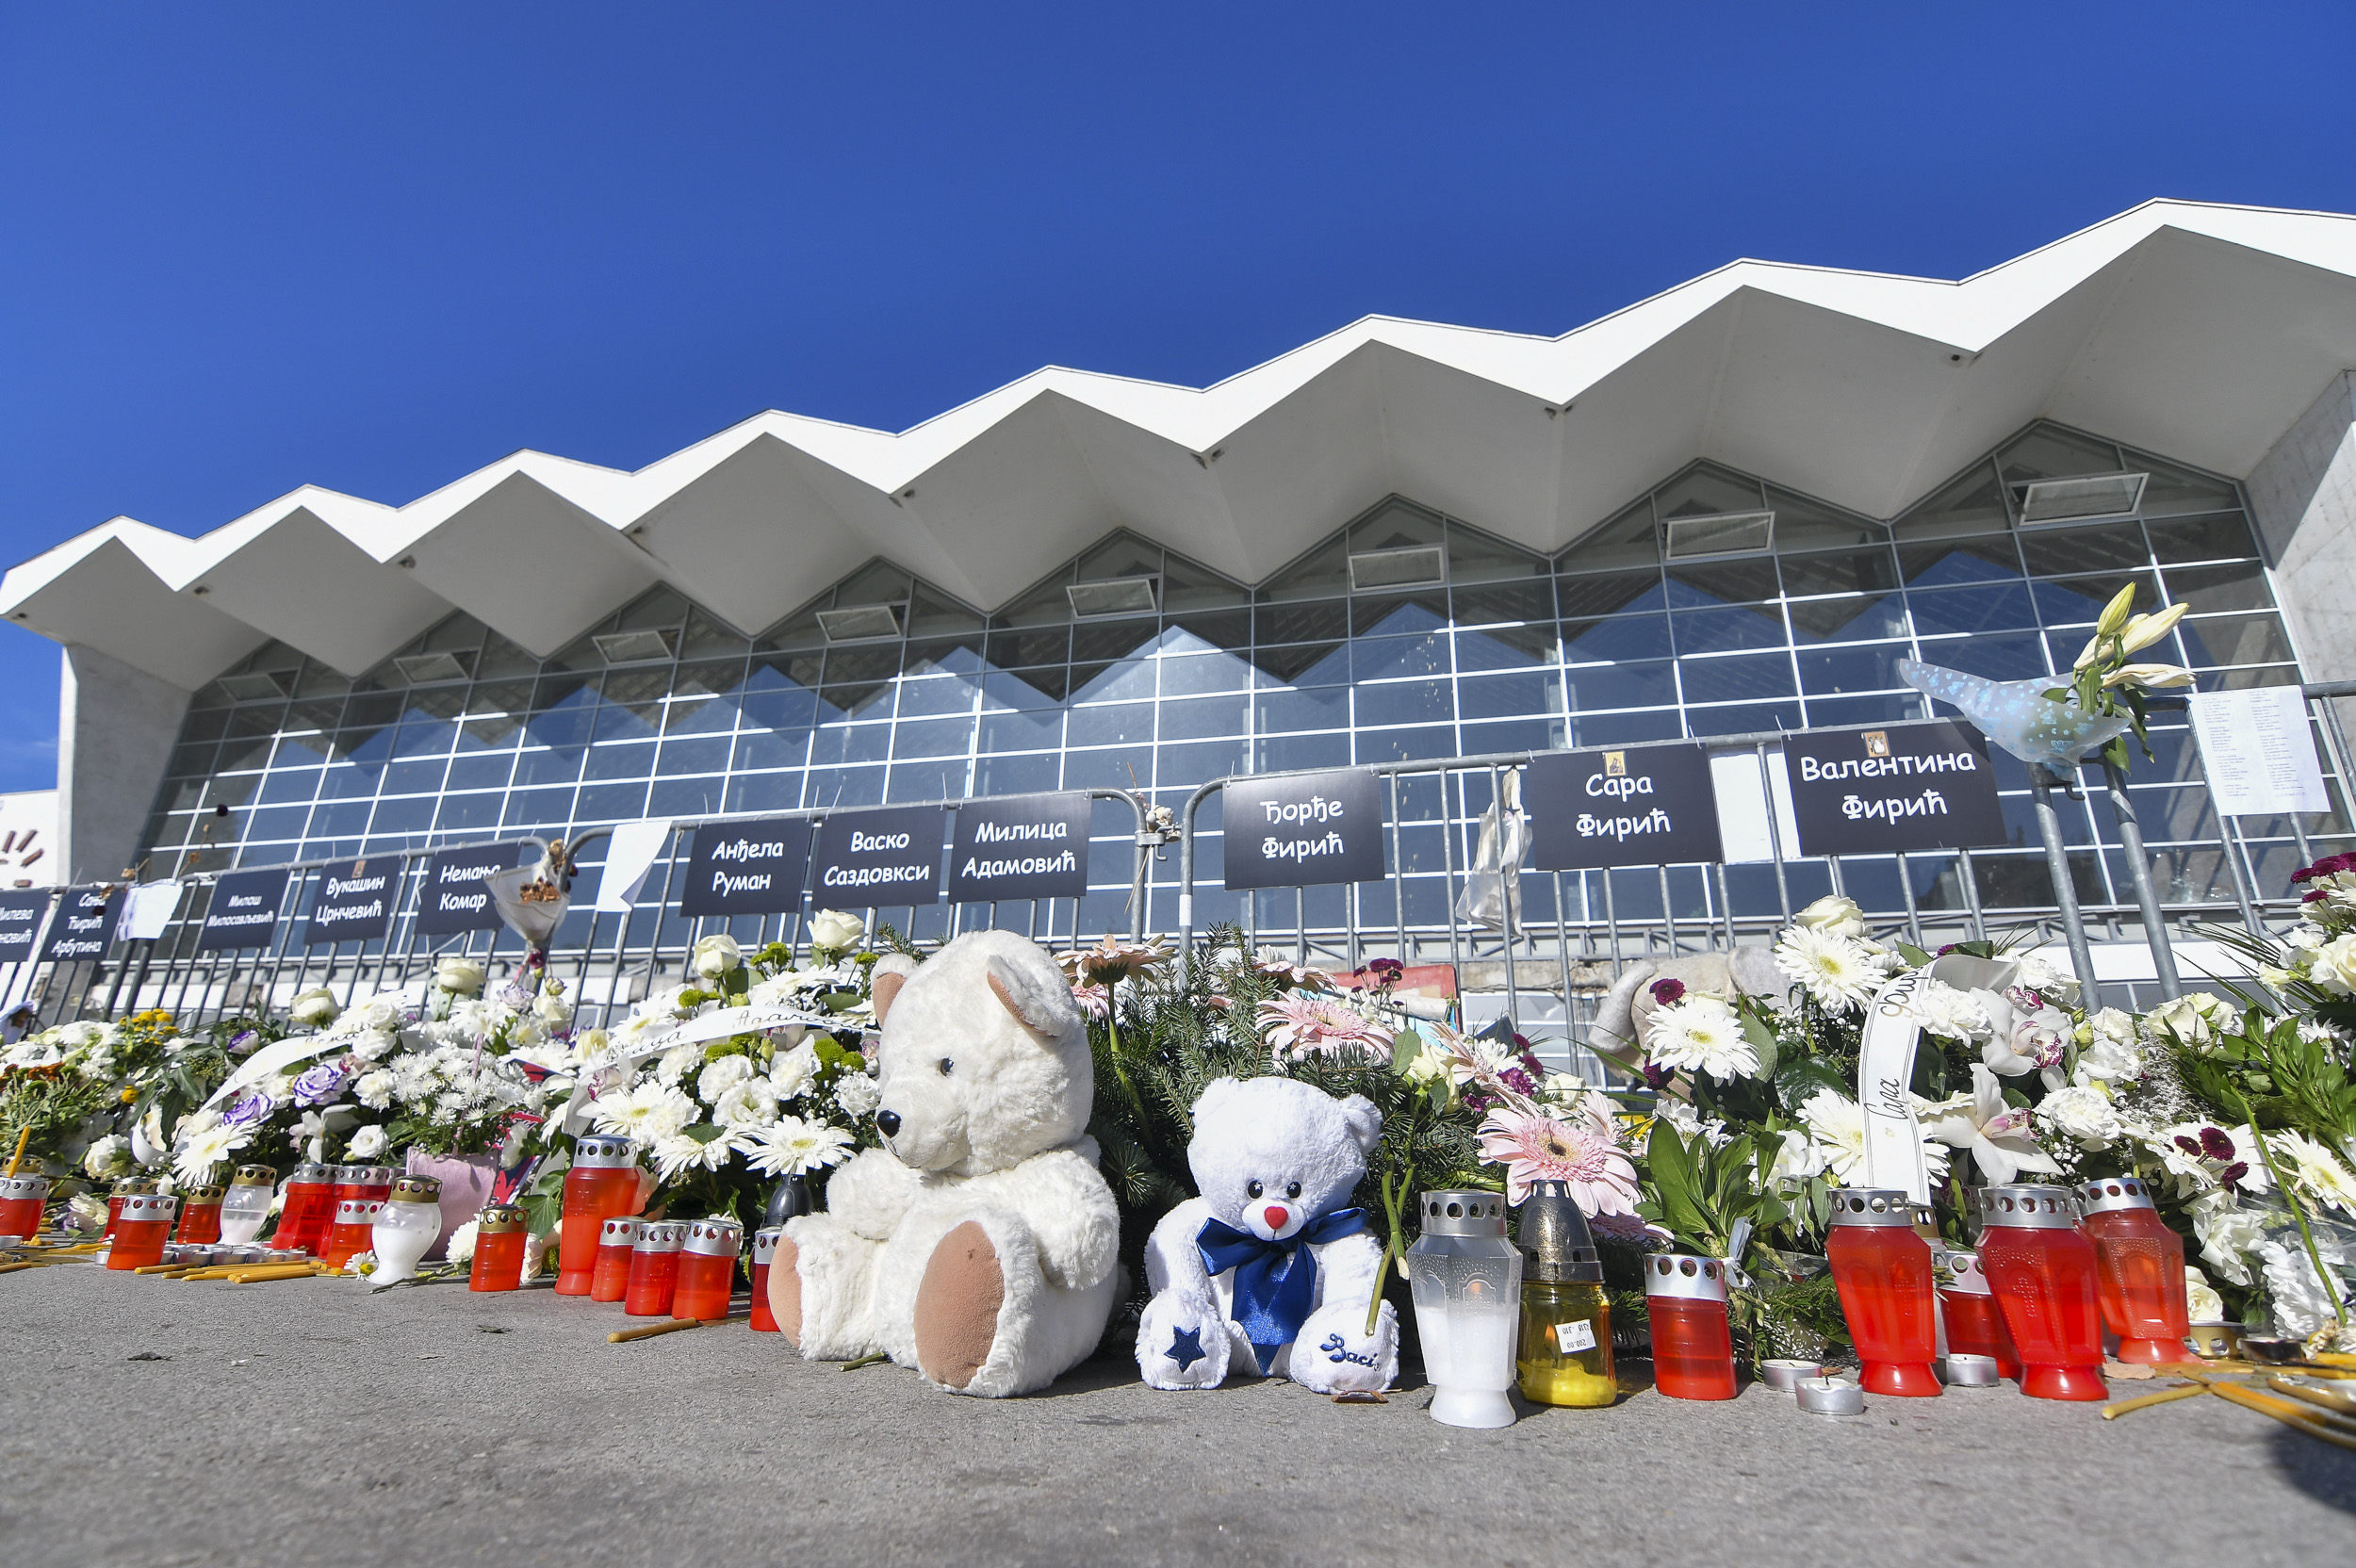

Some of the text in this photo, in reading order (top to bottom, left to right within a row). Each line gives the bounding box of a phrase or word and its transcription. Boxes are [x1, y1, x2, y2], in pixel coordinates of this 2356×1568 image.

[1801, 753, 1975, 781] Валентина
[1586, 774, 1653, 802] Сара
[1259, 795, 1344, 826] Ђорђе
[1842, 789, 1947, 825] Фирић
[975, 822, 1067, 842] Милица
[1577, 808, 1671, 842] Фирић
[712, 838, 784, 862] Анђела
[851, 831, 909, 852] Васко
[1262, 831, 1344, 863] Фирић
[825, 865, 930, 887] Саздовкси
[961, 850, 1075, 879] Адамовић
[326, 876, 385, 899] Вукашин
[712, 871, 772, 897] Руман
[316, 899, 383, 926] Црнчевић
[439, 893, 487, 913] Комар
[51, 939, 103, 957] Арбутина
[1319, 1333, 1378, 1367] Baci
